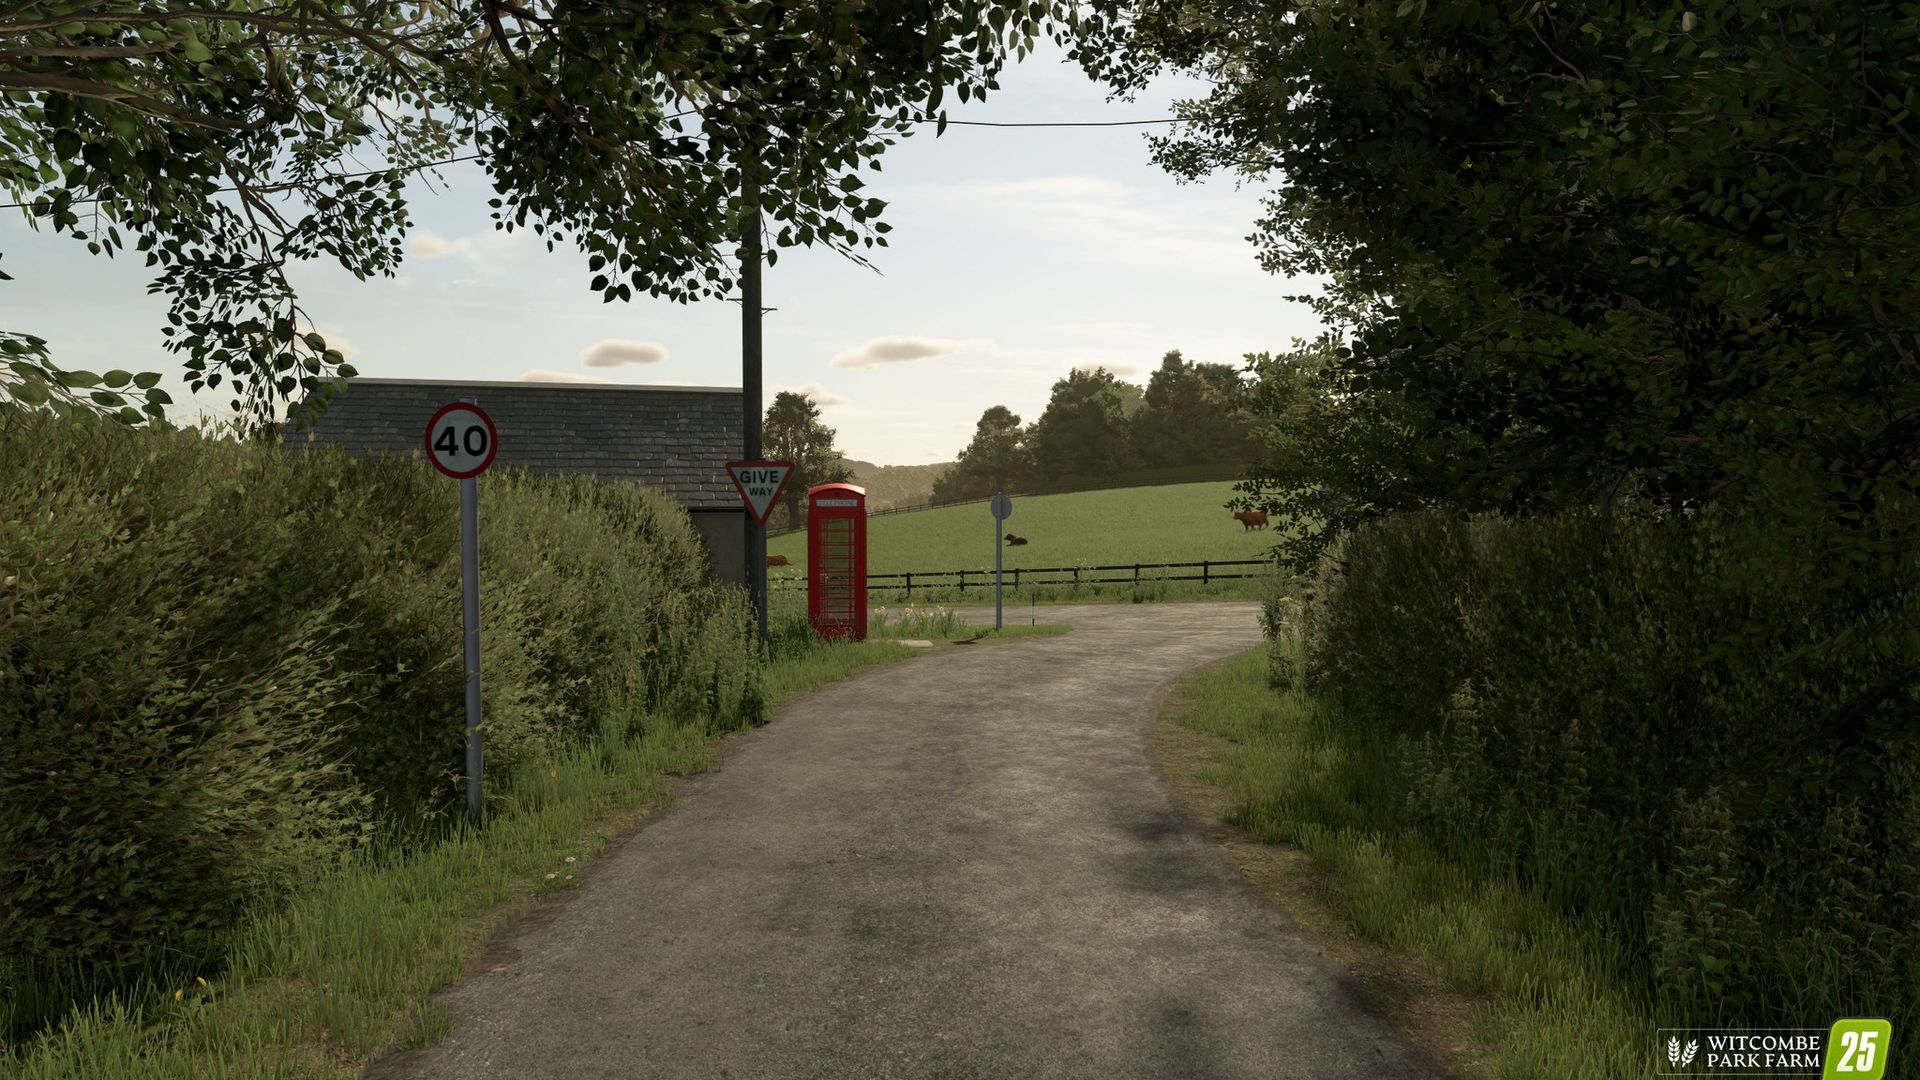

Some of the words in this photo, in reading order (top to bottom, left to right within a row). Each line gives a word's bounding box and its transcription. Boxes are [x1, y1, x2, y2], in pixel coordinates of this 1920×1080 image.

[434, 425, 488, 457] 40
[740, 470, 780, 484] GIVE
[748, 487, 774, 497] WAY
